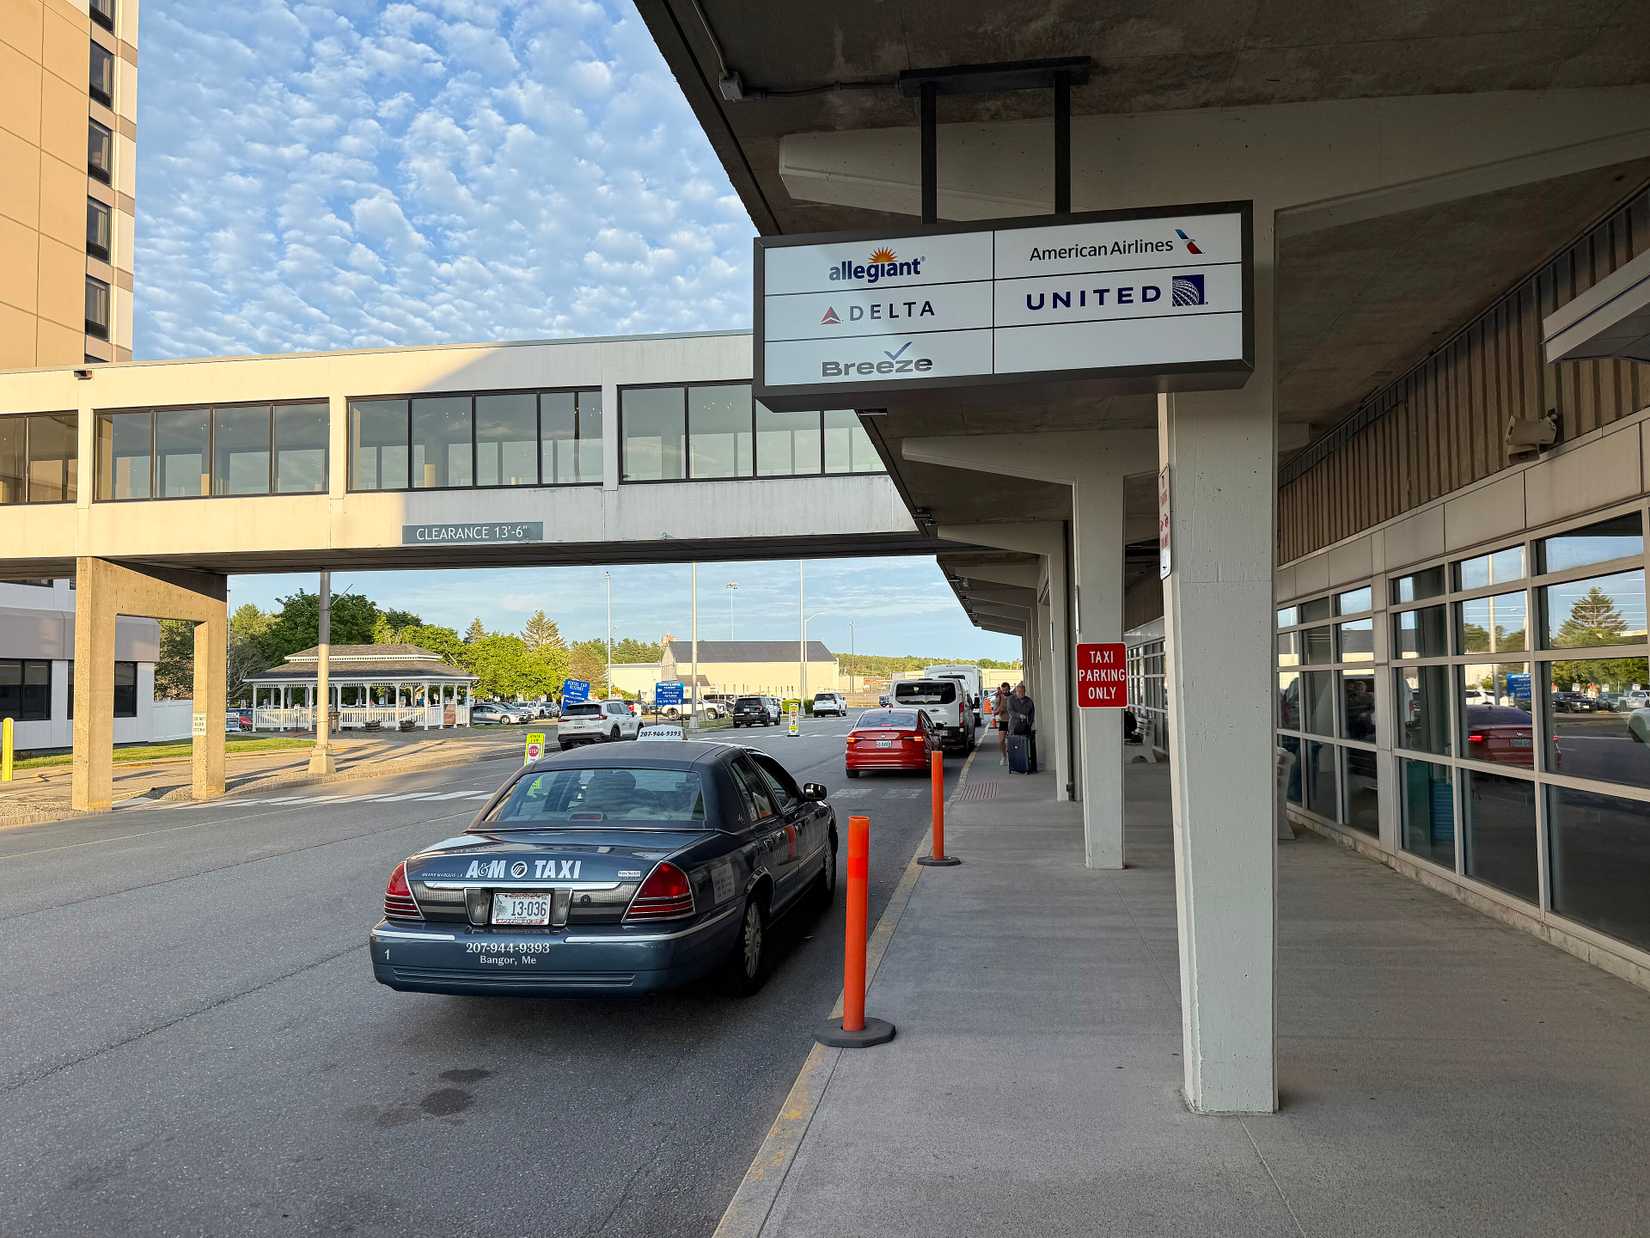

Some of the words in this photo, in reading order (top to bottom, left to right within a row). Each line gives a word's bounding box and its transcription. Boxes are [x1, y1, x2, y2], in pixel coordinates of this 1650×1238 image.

[1029, 243, 1107, 261] American
[1110, 239, 1174, 256] Airlines
[829, 258, 921, 283] allegiant
[1026, 285, 1161, 310] UNITED
[849, 300, 935, 322] DELTA
[821, 358, 933, 377] Breeze
[416, 526, 490, 540] CLEARANCE
[1089, 650, 1114, 664] TAXI
[1078, 669, 1126, 682] PARKING
[1088, 686, 1117, 700] ONLY
[465, 860, 507, 879] A&M
[534, 860, 582, 879] TAXI
[384, 949, 391, 960] 1
[465, 942, 551, 953] 207-944-9393
[480, 955, 518, 966] Bangor,
[521, 956, 537, 965] Me
